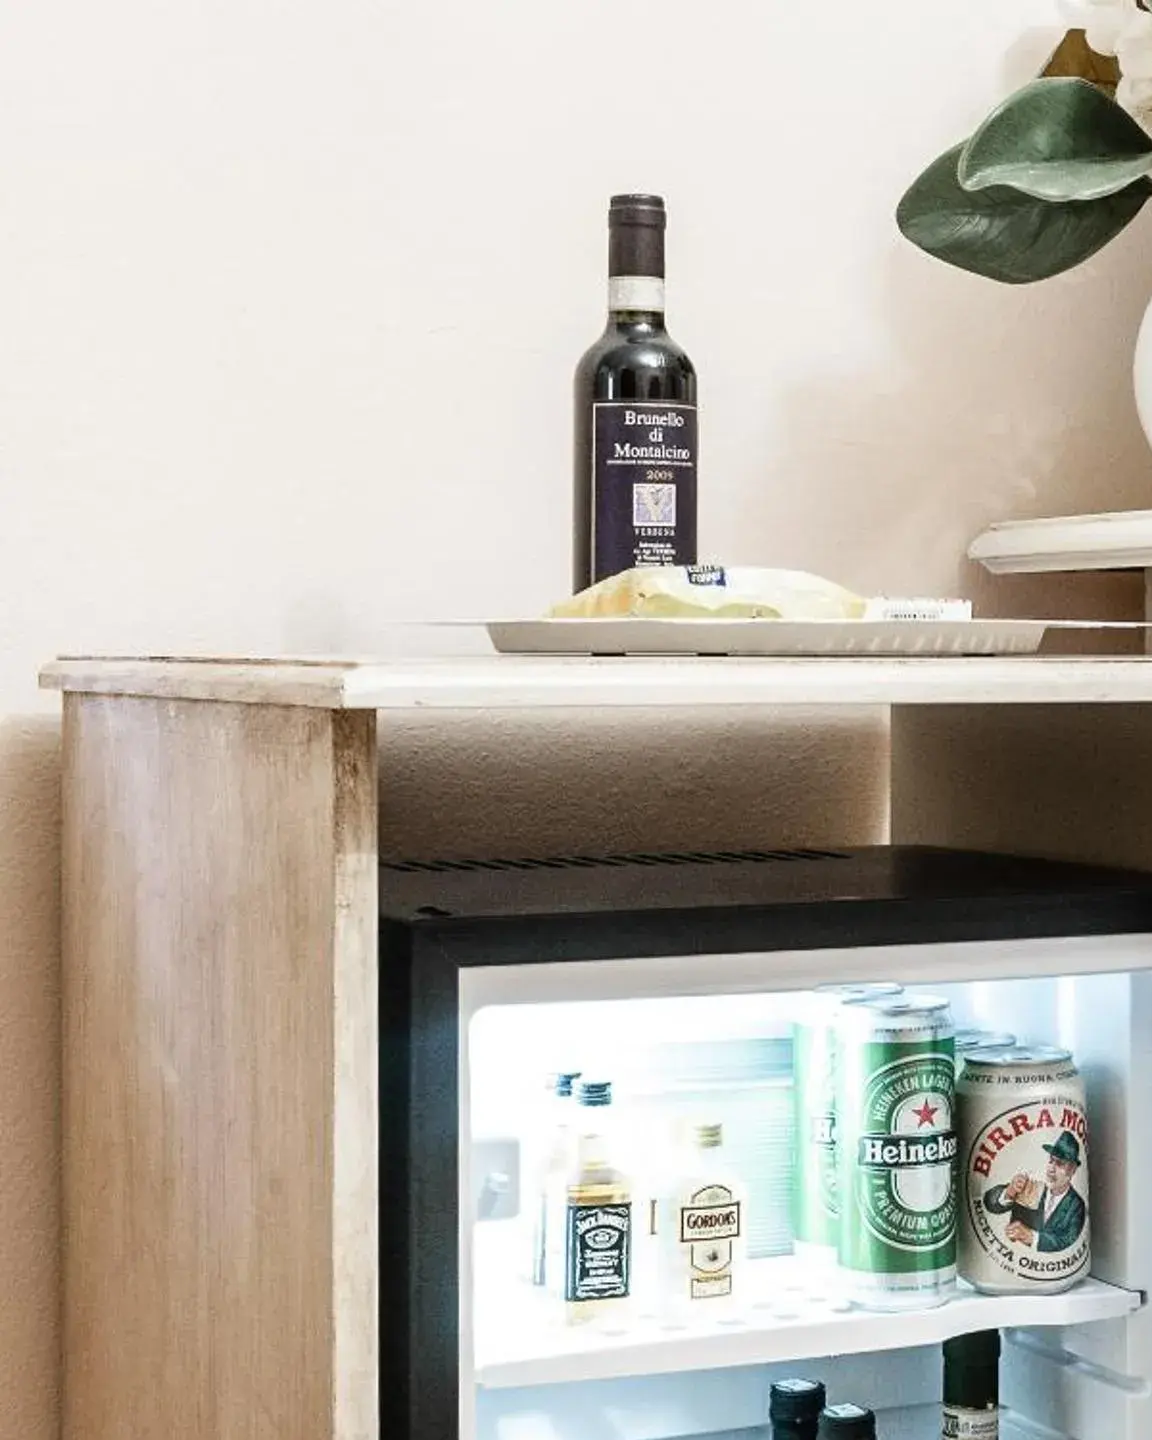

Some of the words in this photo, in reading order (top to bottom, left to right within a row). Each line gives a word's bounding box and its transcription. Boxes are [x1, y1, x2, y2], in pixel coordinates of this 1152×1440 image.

[624, 410, 684, 428] Brunello
[649, 428, 663, 442] di
[614, 443, 690, 460] Montalcino
[973, 1108, 1055, 1177] BIRRA
